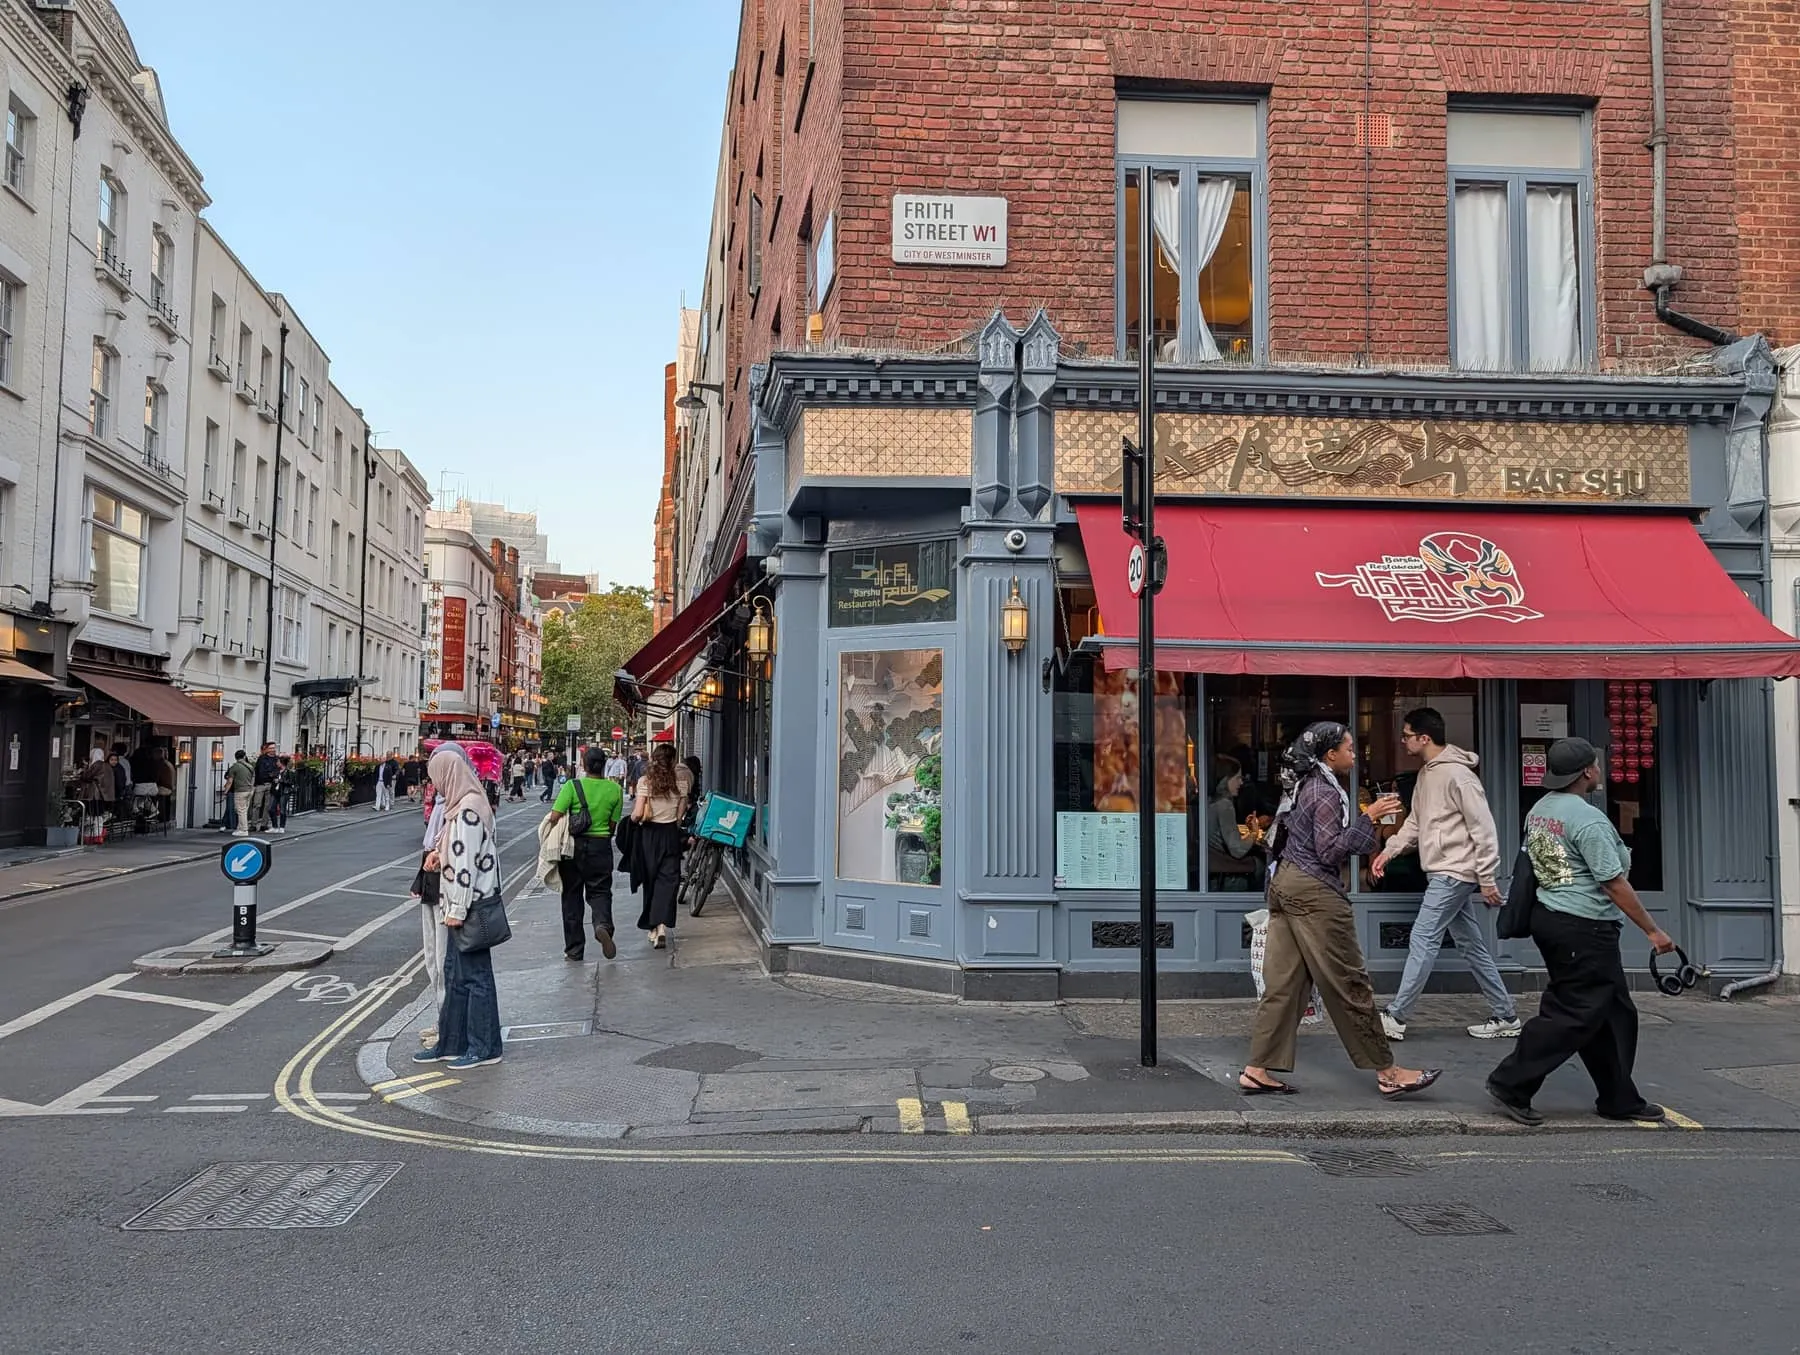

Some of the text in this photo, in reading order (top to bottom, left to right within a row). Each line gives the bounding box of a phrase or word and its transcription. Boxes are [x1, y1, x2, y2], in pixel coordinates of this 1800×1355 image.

[904, 202, 954, 220] FRITH
[904, 223, 996, 242] STREET W1
[904, 250, 992, 261] CITY OF WESTMINSTER
[1502, 467, 1650, 496] BAR SHU
[1129, 555, 1143, 582] 20
[854, 587, 881, 598] Barshu
[838, 600, 881, 609] Restaurant
[444, 672, 462, 681] PUB
[239, 906, 248, 915] B
[240, 917, 248, 926] 3
